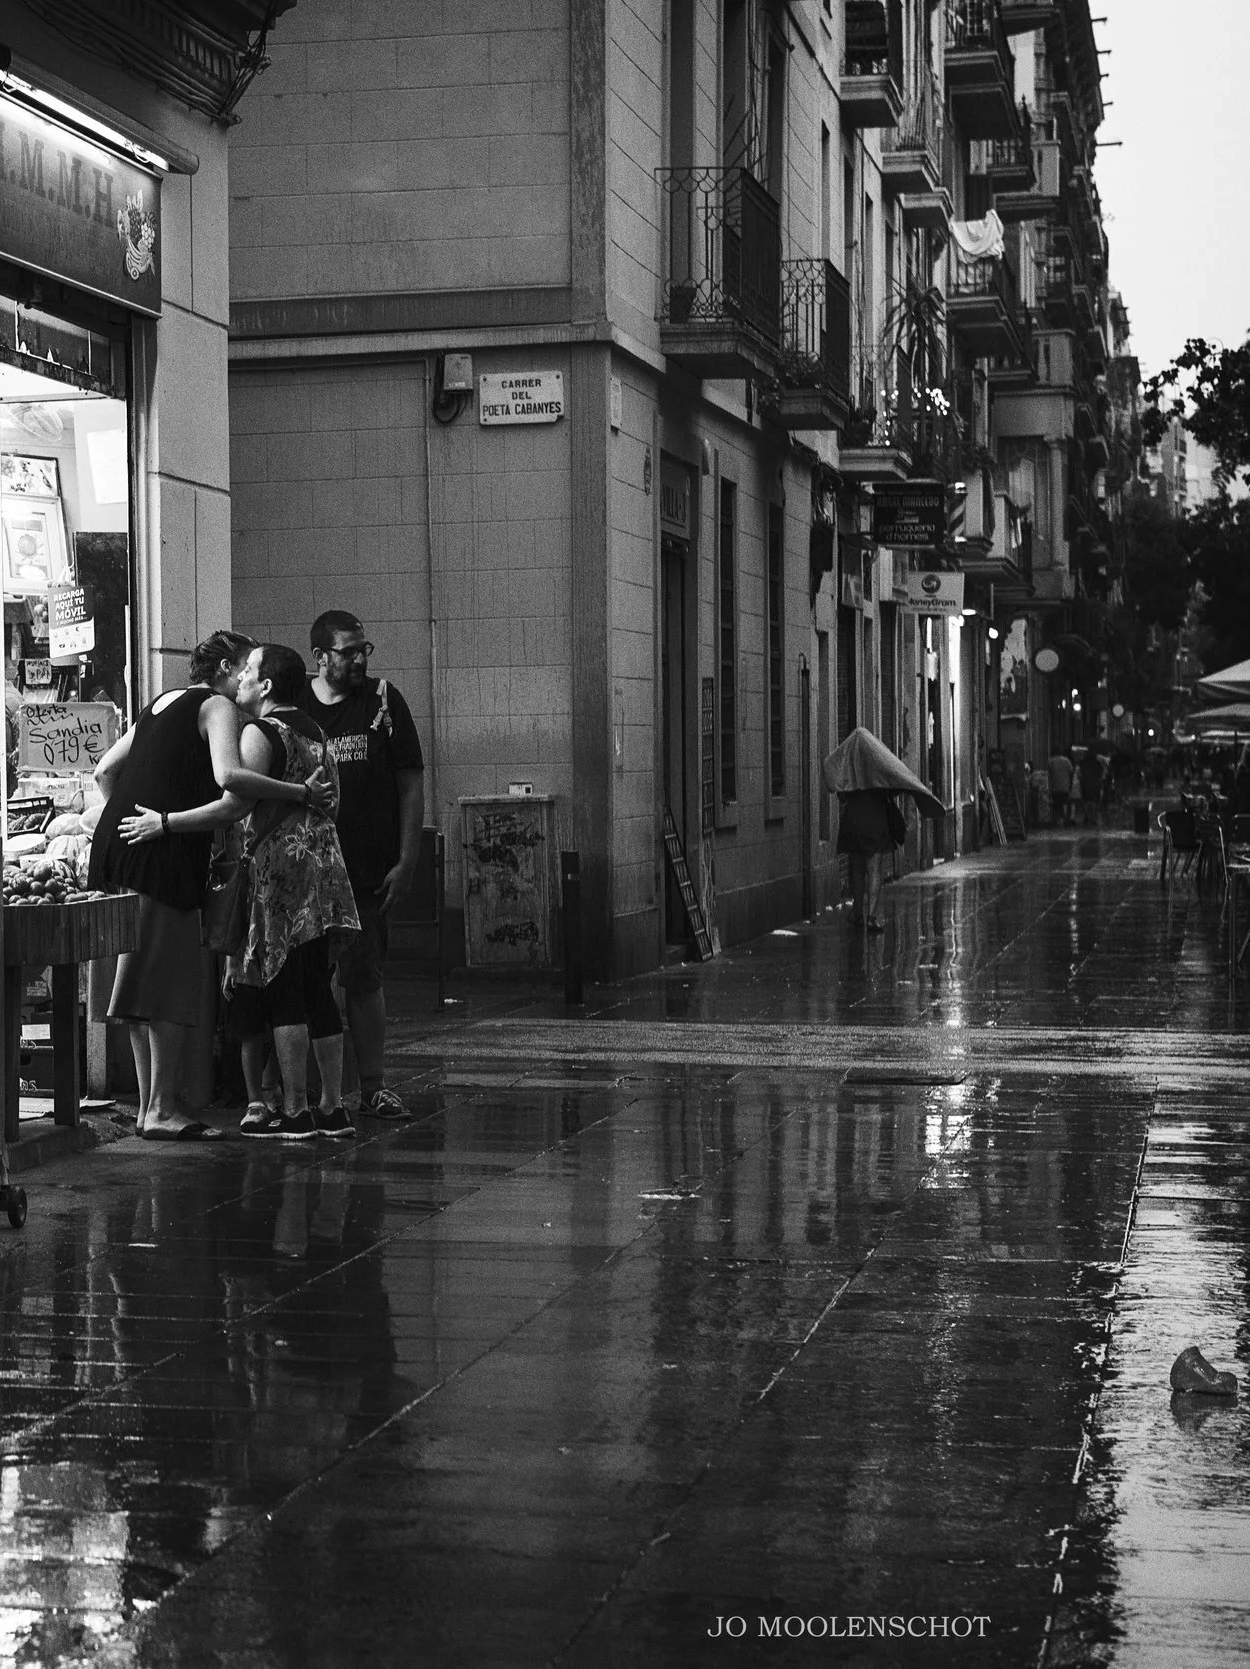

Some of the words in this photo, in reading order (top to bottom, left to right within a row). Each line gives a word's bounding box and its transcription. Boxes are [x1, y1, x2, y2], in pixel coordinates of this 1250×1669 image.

[501, 379, 542, 389] CARRER
[511, 391, 532, 400] DEL
[482, 404, 511, 416] POETA
[514, 401, 562, 415] CABANYES
[53, 588, 85, 602] RECARGA
[74, 596, 85, 606] TU
[55, 605, 86, 621] MÓVIL
[25, 703, 68, 719] Oferta
[28, 716, 103, 744] Sandia
